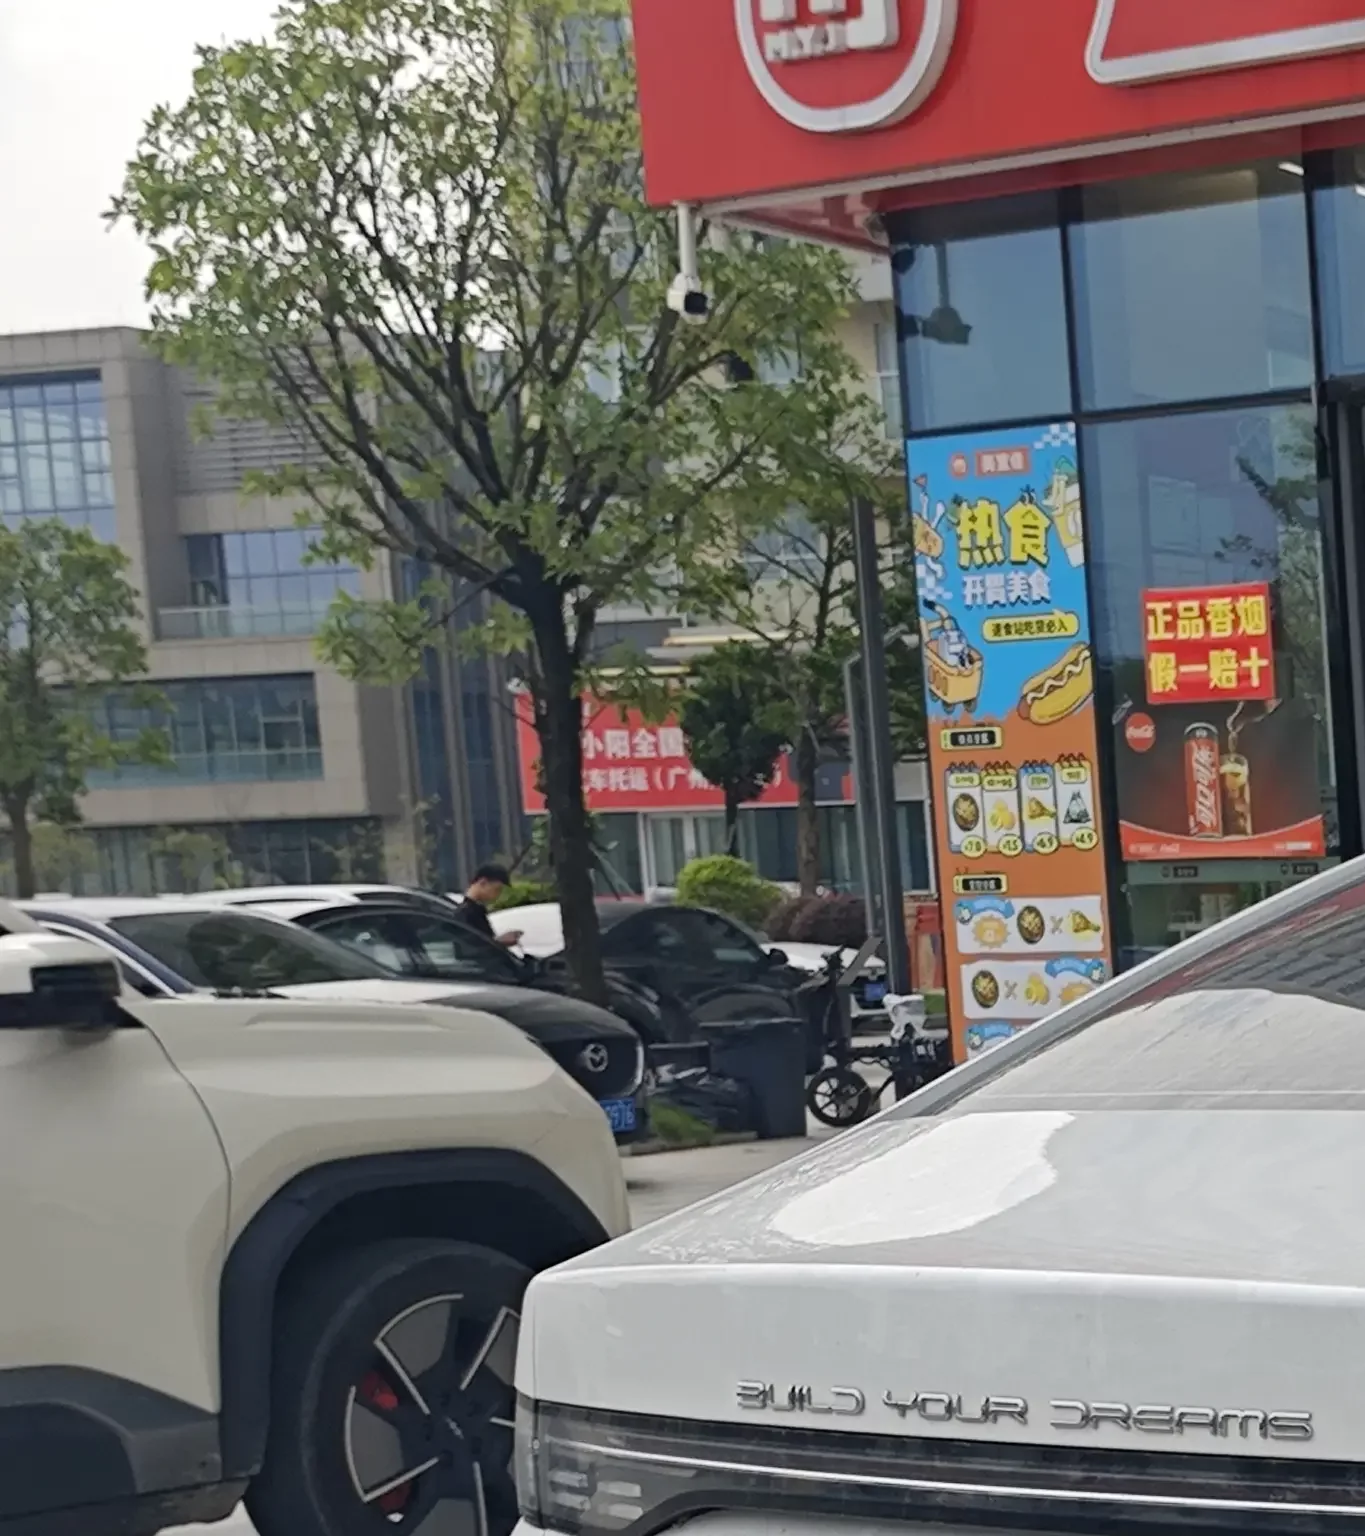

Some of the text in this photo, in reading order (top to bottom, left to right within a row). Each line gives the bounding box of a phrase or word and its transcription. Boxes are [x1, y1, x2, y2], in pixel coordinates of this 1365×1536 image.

[957, 496, 1051, 570] 热食
[1146, 594, 1268, 641] 正品香烟
[1149, 646, 1269, 694] 假一赔十
[736, 1379, 1314, 1441] BUILD YOUR DREAMS
